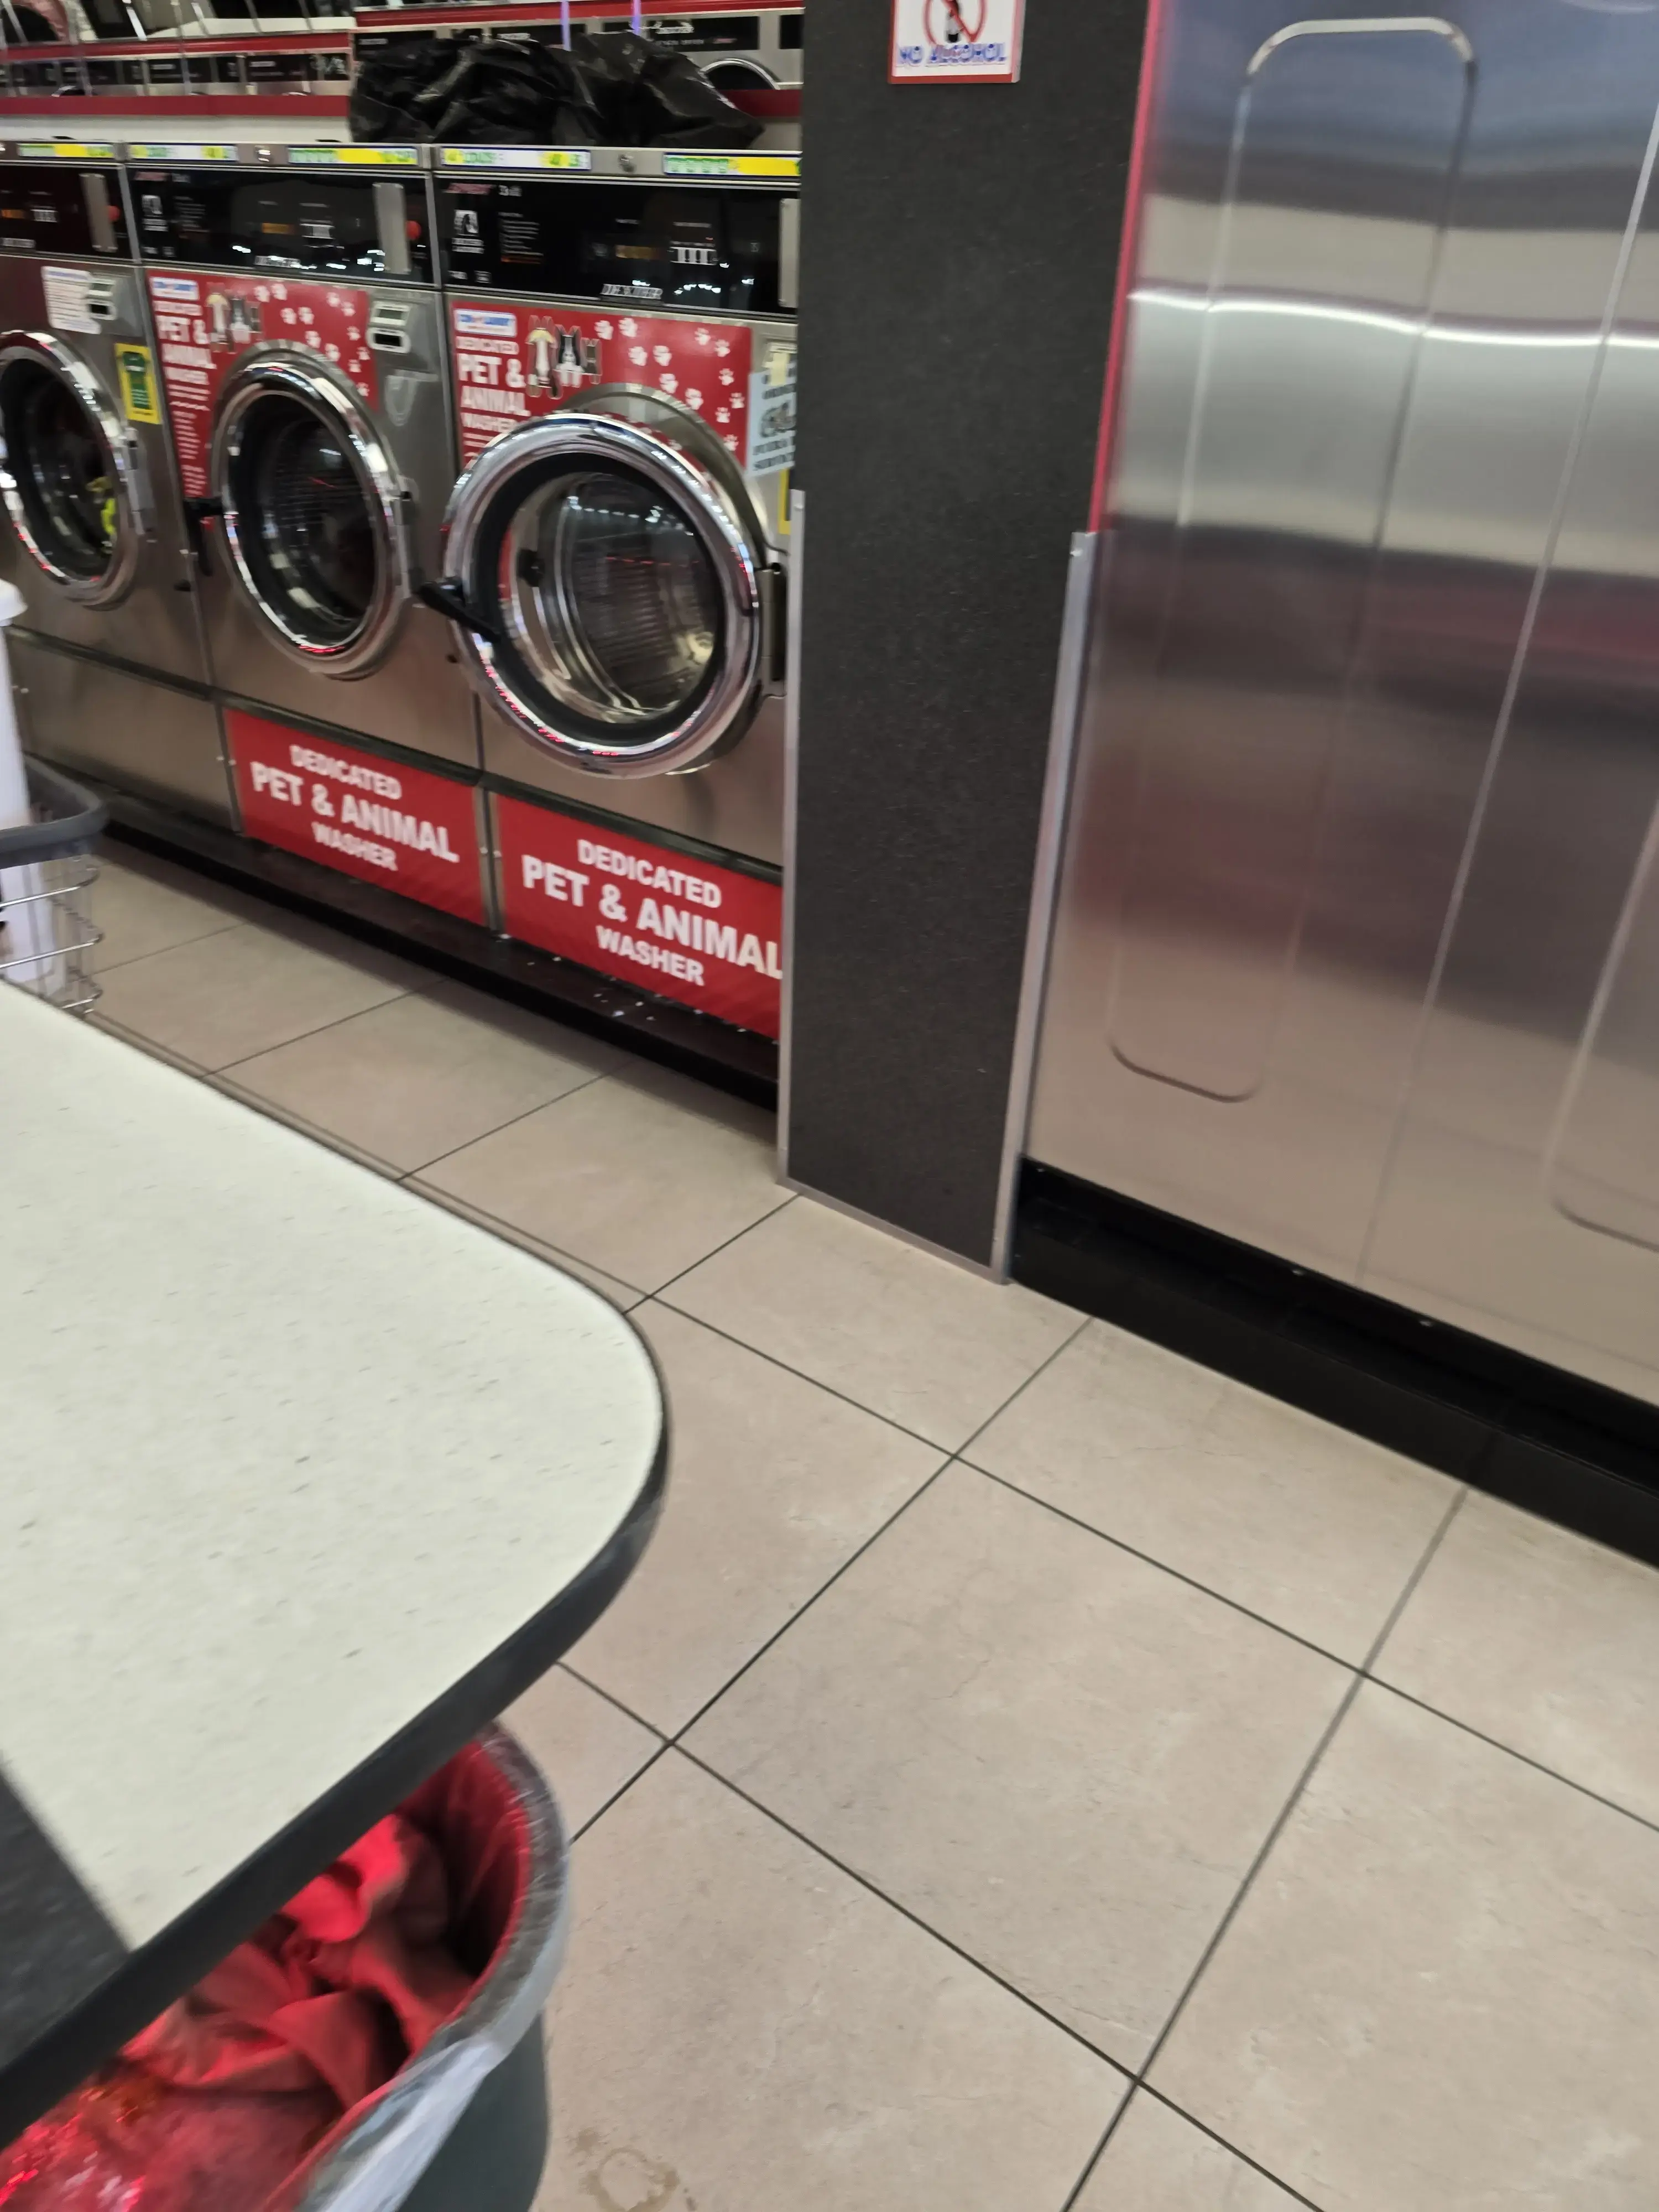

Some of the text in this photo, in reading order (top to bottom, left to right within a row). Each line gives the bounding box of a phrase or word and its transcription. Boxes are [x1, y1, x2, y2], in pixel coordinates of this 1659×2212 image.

[928, 43, 1005, 65] ALCOHOL
[457, 353, 526, 388] PET &
[461, 385, 531, 416] ANIMAL
[289, 744, 402, 800] DEDICATED
[250, 761, 460, 863] PET & ANIMAL
[311, 821, 399, 871] WASHER
[577, 838, 722, 909] DEDICATED
[521, 854, 783, 980] PET & ANIMAL
[595, 925, 705, 987] WASHER
